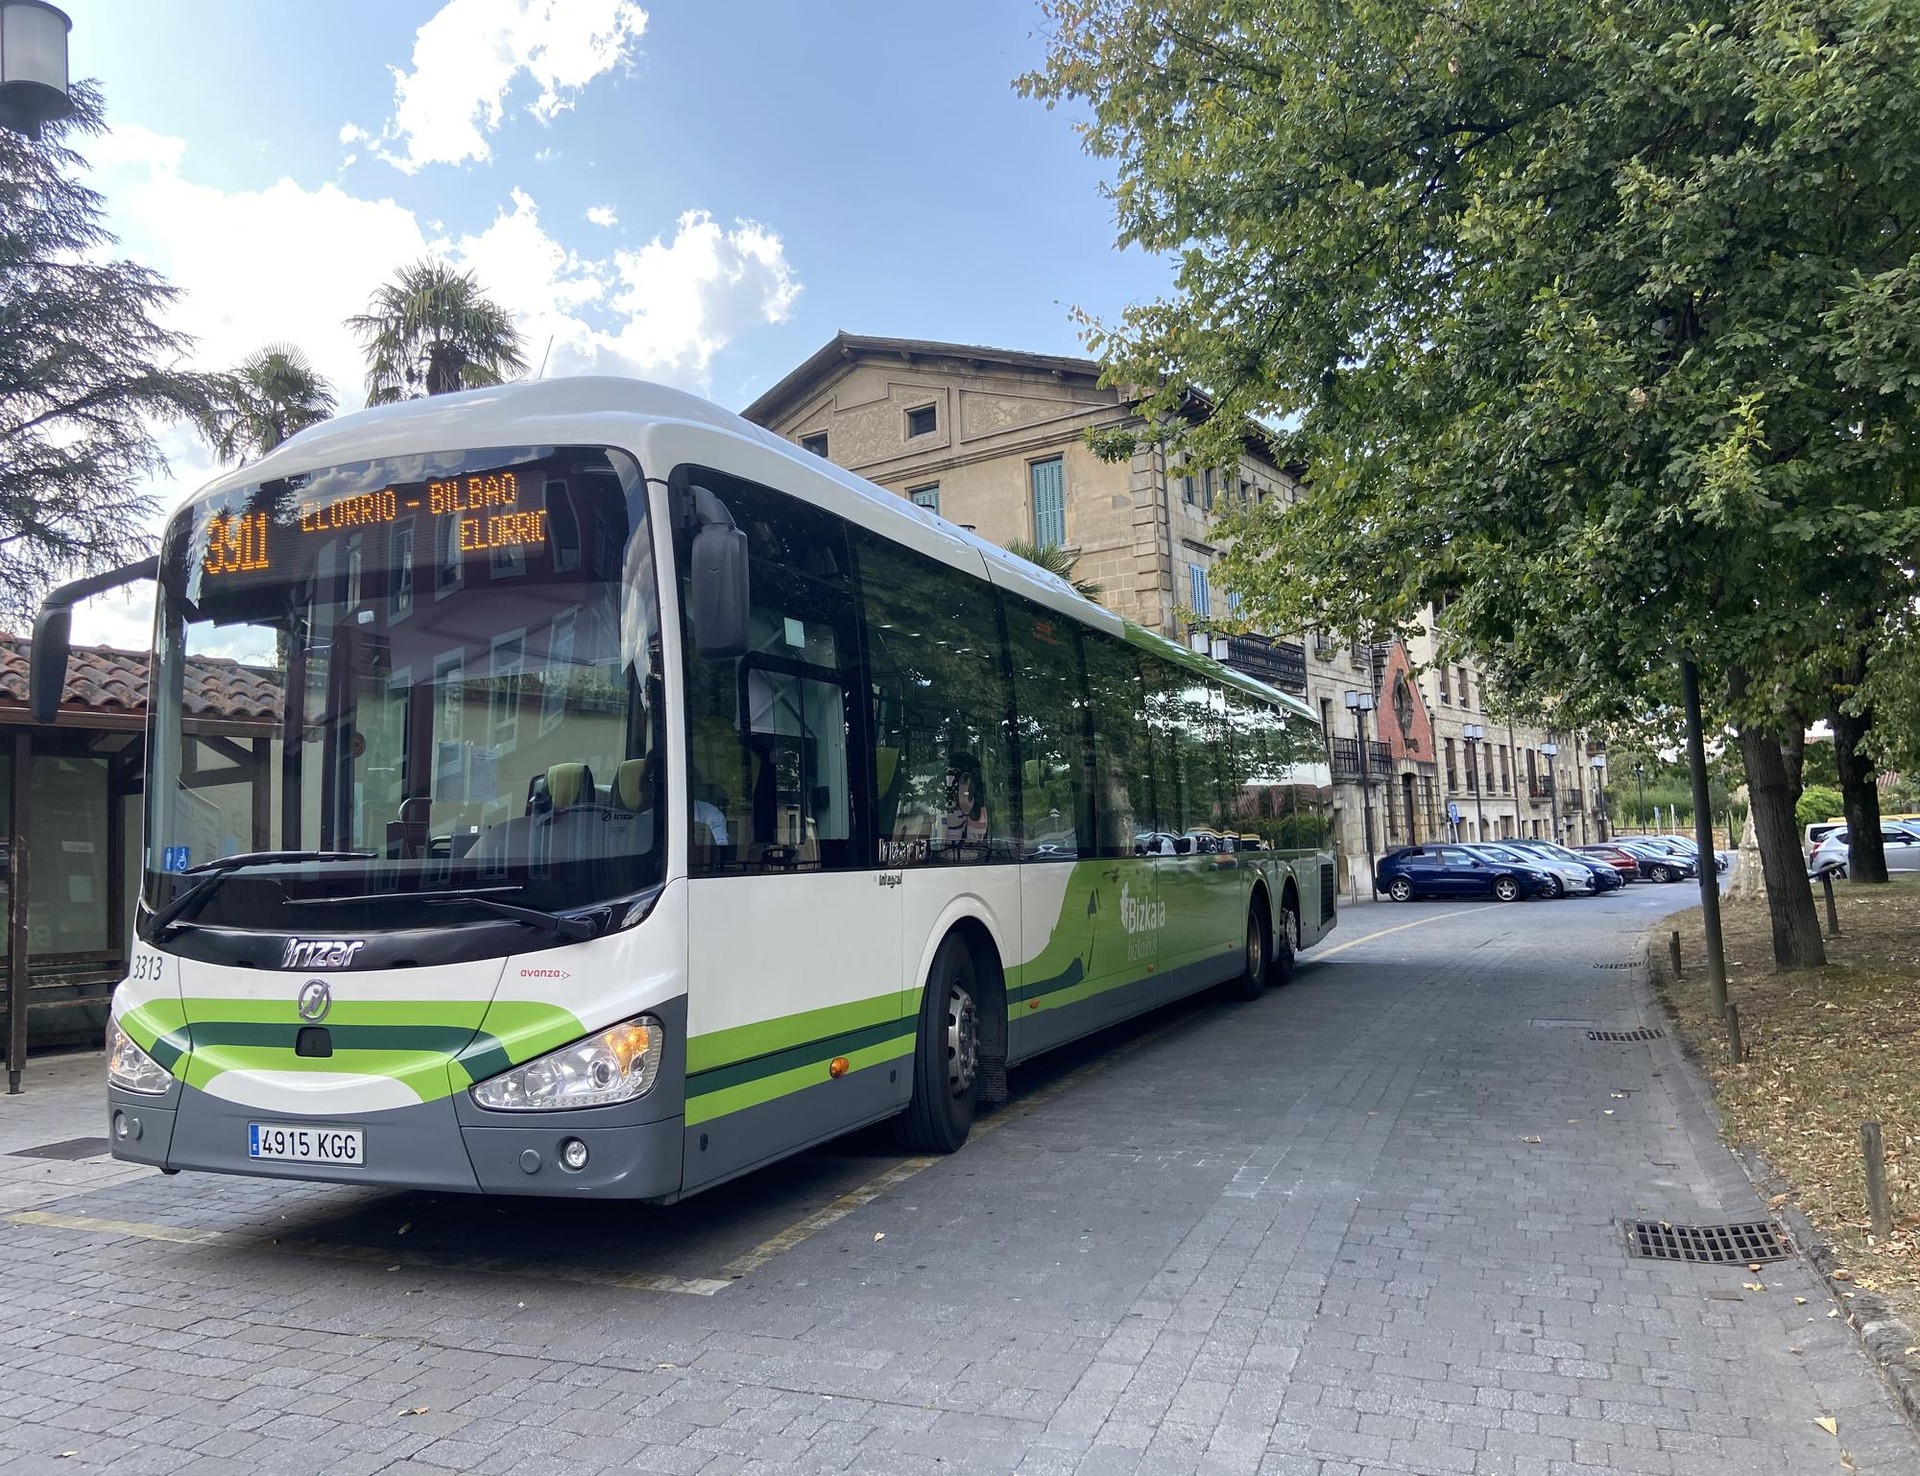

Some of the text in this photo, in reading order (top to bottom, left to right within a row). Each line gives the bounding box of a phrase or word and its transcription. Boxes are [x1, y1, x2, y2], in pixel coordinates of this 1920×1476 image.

[302, 490, 397, 532] ELORRIO
[429, 472, 516, 515] BILBAO
[205, 512, 269, 575] 3911
[1128, 893, 1166, 935] Bizkaia
[132, 954, 163, 982] 3313
[281, 936, 366, 969] Irizar
[519, 968, 561, 978] avanza
[252, 1129, 357, 1160] E 4915 KGG
